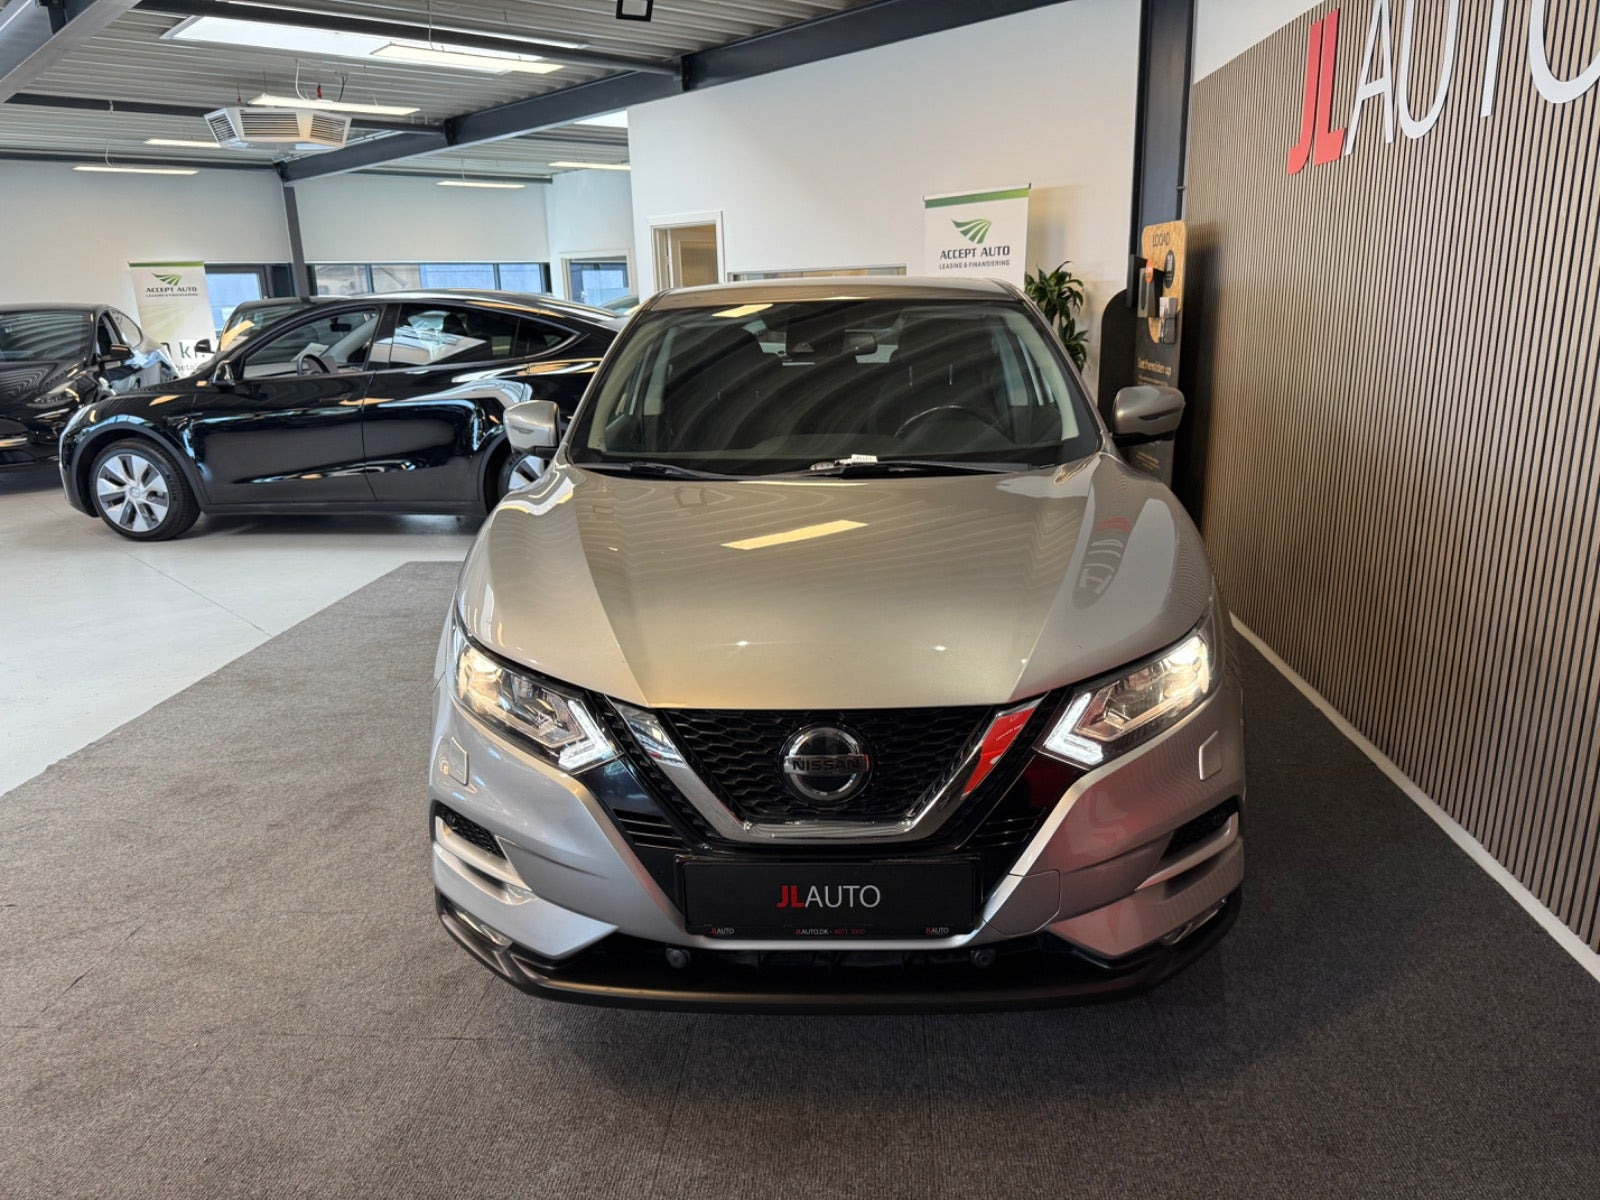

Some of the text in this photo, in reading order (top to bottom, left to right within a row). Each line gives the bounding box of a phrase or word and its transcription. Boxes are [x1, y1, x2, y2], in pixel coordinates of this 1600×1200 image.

[940, 245, 1010, 260] ACCEPT AUTO
[939, 262, 963, 270] LEASING
[969, 260, 1010, 268] FINANSIERING
[792, 759, 858, 772] NISSAN
[776, 884, 881, 908] JLAUTO
